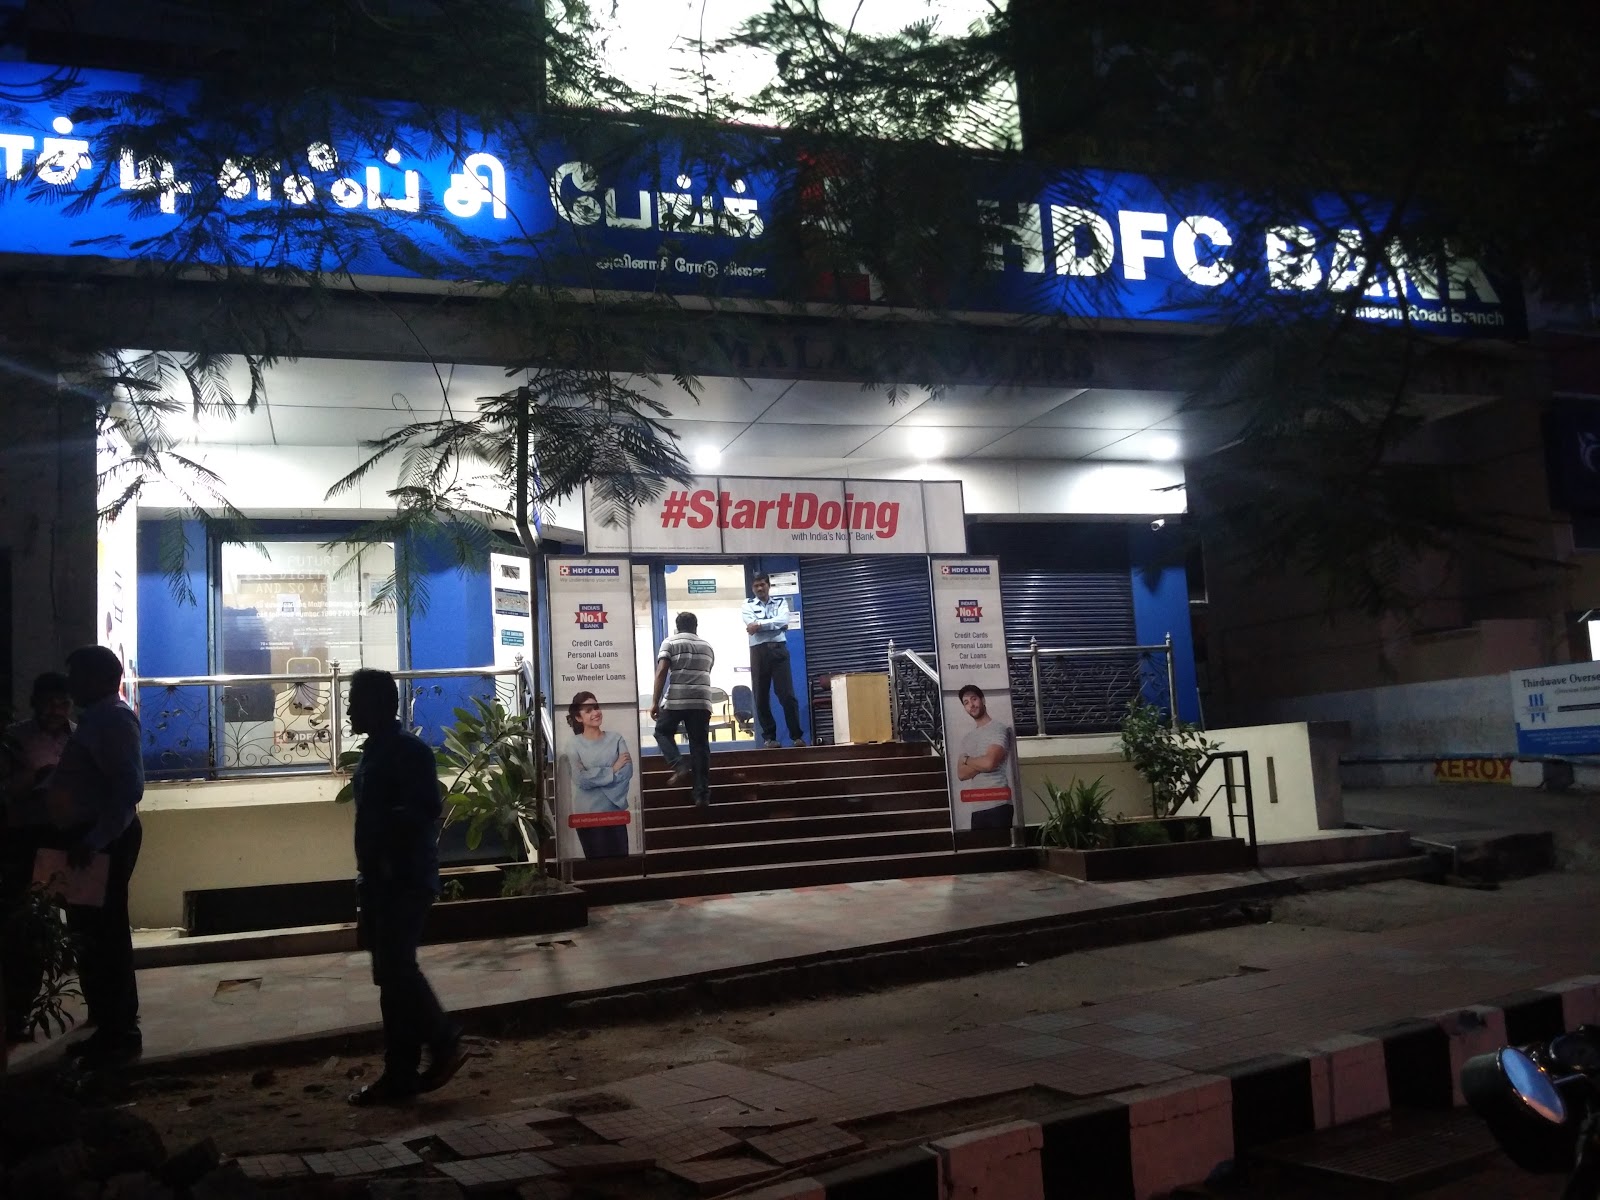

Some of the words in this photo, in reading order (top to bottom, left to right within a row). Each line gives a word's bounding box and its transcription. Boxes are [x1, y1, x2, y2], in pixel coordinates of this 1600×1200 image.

[977, 199, 1234, 287] HDFC
[1265, 225, 1500, 304] BANK
[674, 257, 718, 279] ரோடு
[1407, 304, 1447, 322] Road
[660, 489, 900, 539] #StartDoing
[791, 532, 807, 541] with
[809, 532, 834, 541] India's
[855, 532, 875, 541] Bank
[572, 567, 592, 575] HDFC
[594, 567, 616, 575] BANK
[579, 612, 603, 623] No.1
[959, 607, 978, 617] No.1
[590, 662, 610, 670] Loans
[1521, 676, 1567, 689] Thirdwave
[1433, 758, 1513, 780] XEROX
